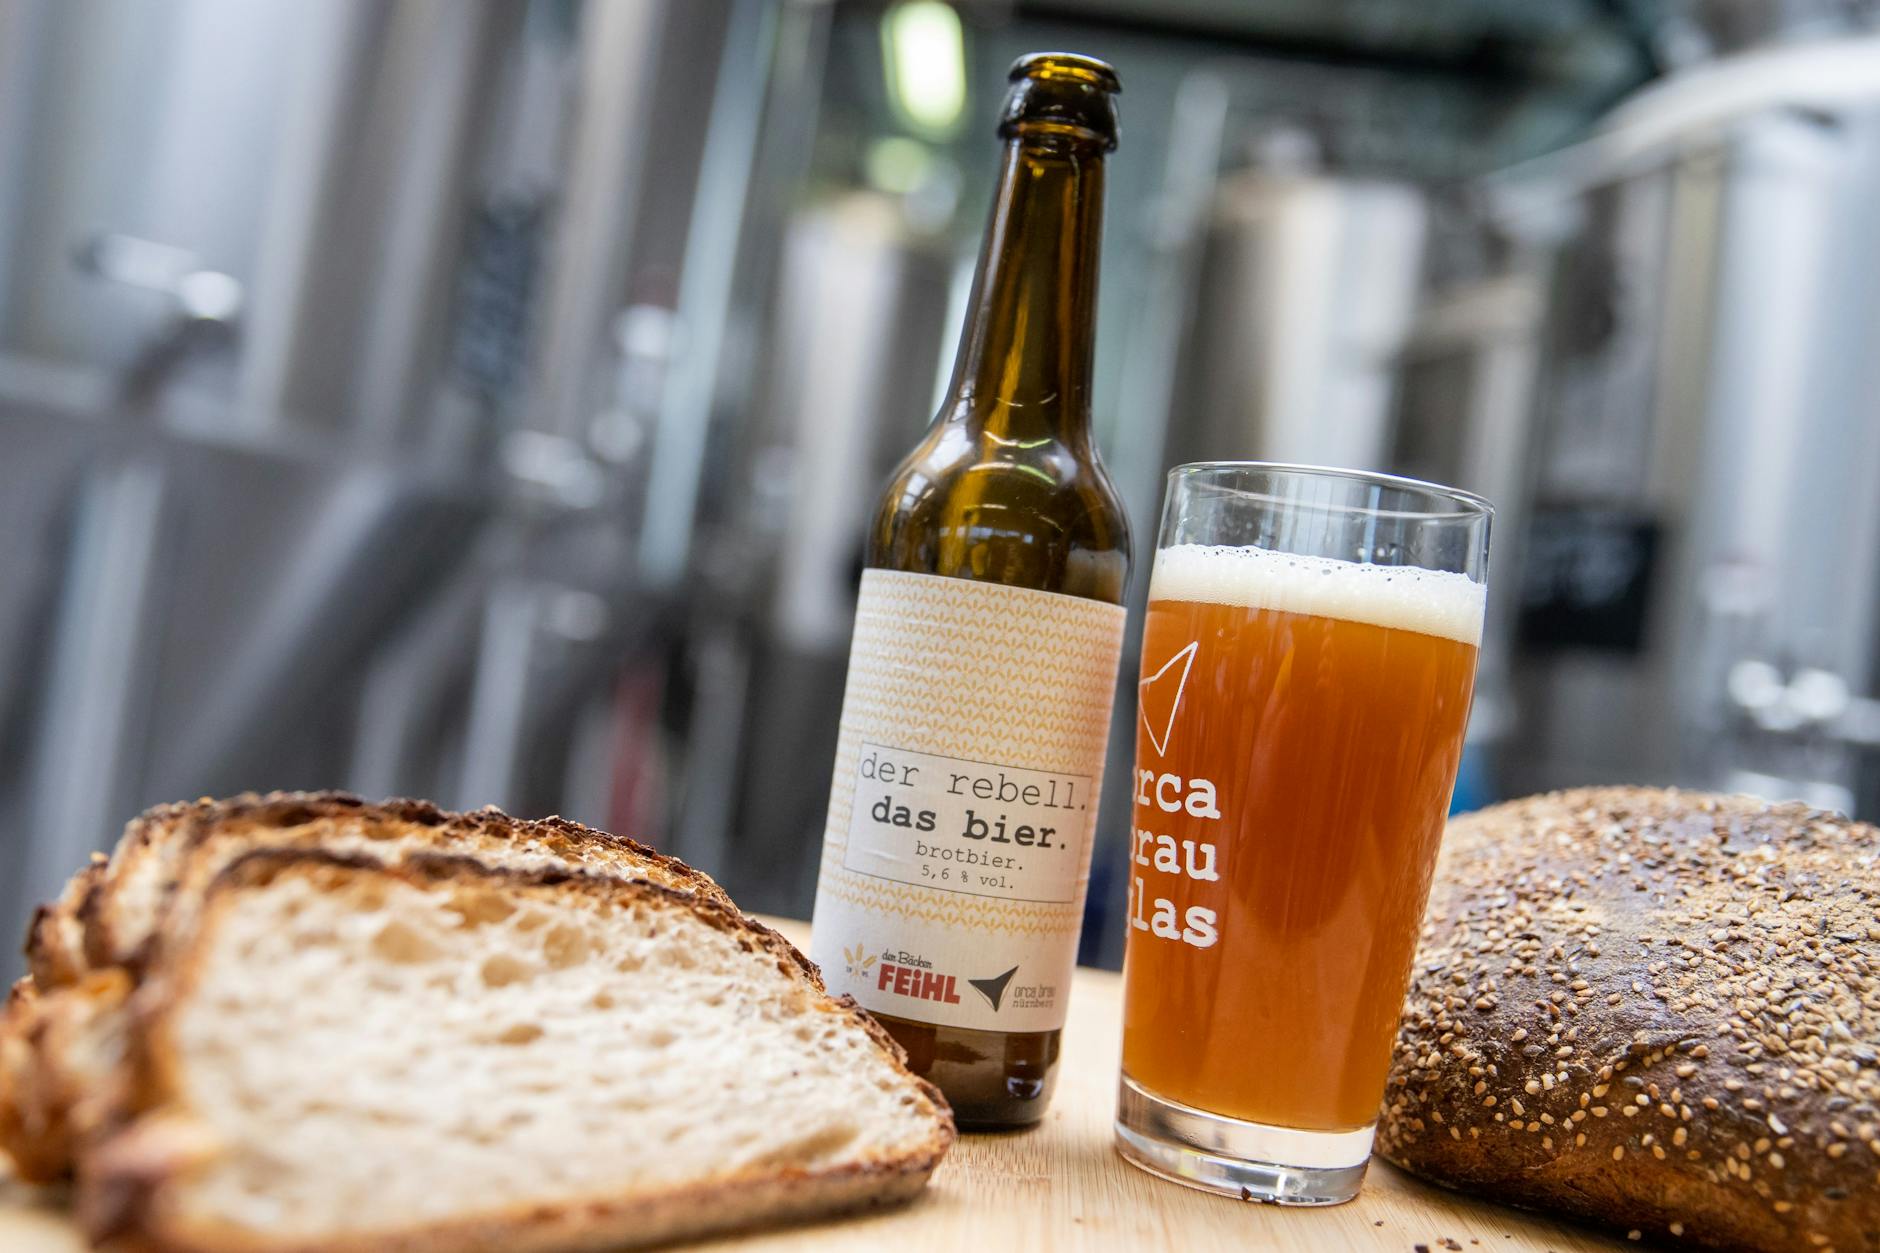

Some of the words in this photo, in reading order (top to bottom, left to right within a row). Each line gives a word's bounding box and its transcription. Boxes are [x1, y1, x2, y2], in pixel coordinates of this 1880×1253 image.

[861, 753, 920, 788] der
[946, 774, 1086, 811] rebell.
[872, 796, 937, 832] das
[962, 810, 1066, 850] bier.
[915, 841, 1024, 871] brotbier.
[921, 864, 950, 880] 5,6
[960, 871, 969, 883] %
[980, 876, 1014, 890] vol.
[1126, 877, 1219, 948] las
